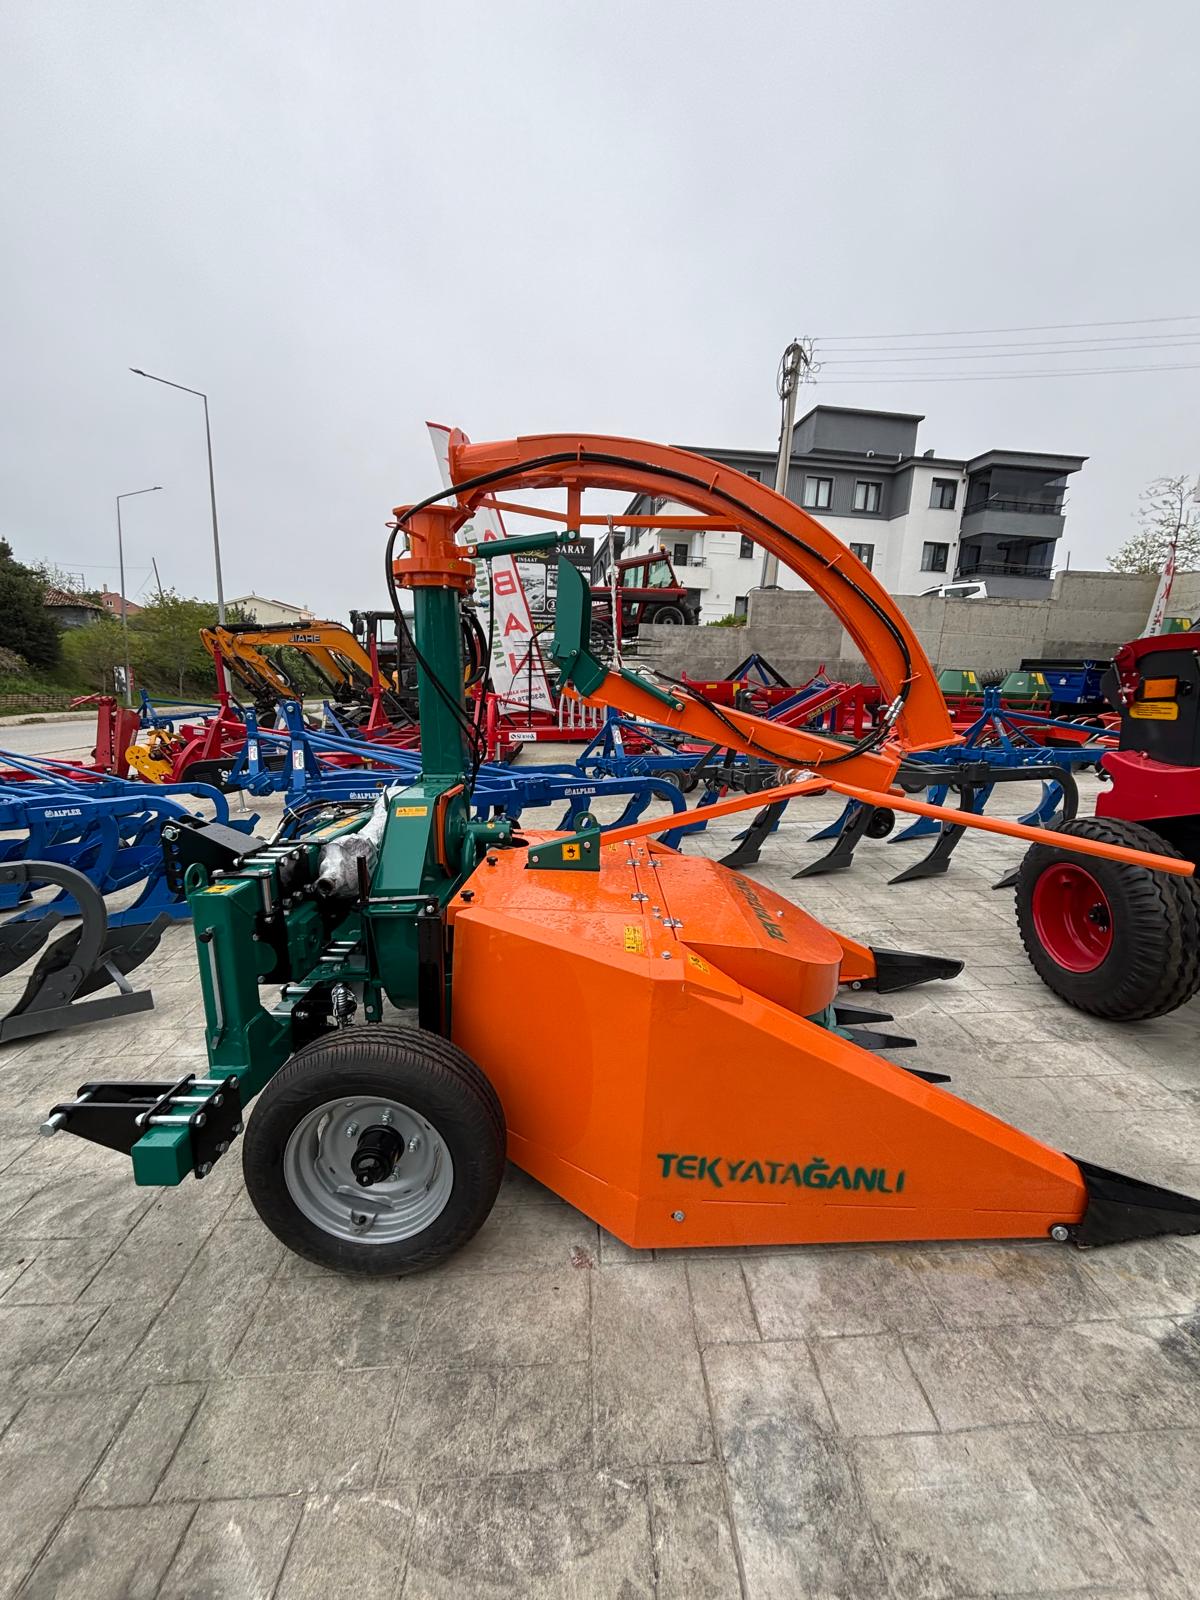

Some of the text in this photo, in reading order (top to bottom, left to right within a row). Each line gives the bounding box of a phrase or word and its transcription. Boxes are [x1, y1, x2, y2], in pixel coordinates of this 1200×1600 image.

[555, 545, 587, 554] SARAY
[288, 633, 321, 643] JIAHE
[573, 787, 597, 795] ALPLER
[54, 808, 82, 817] ALPLER
